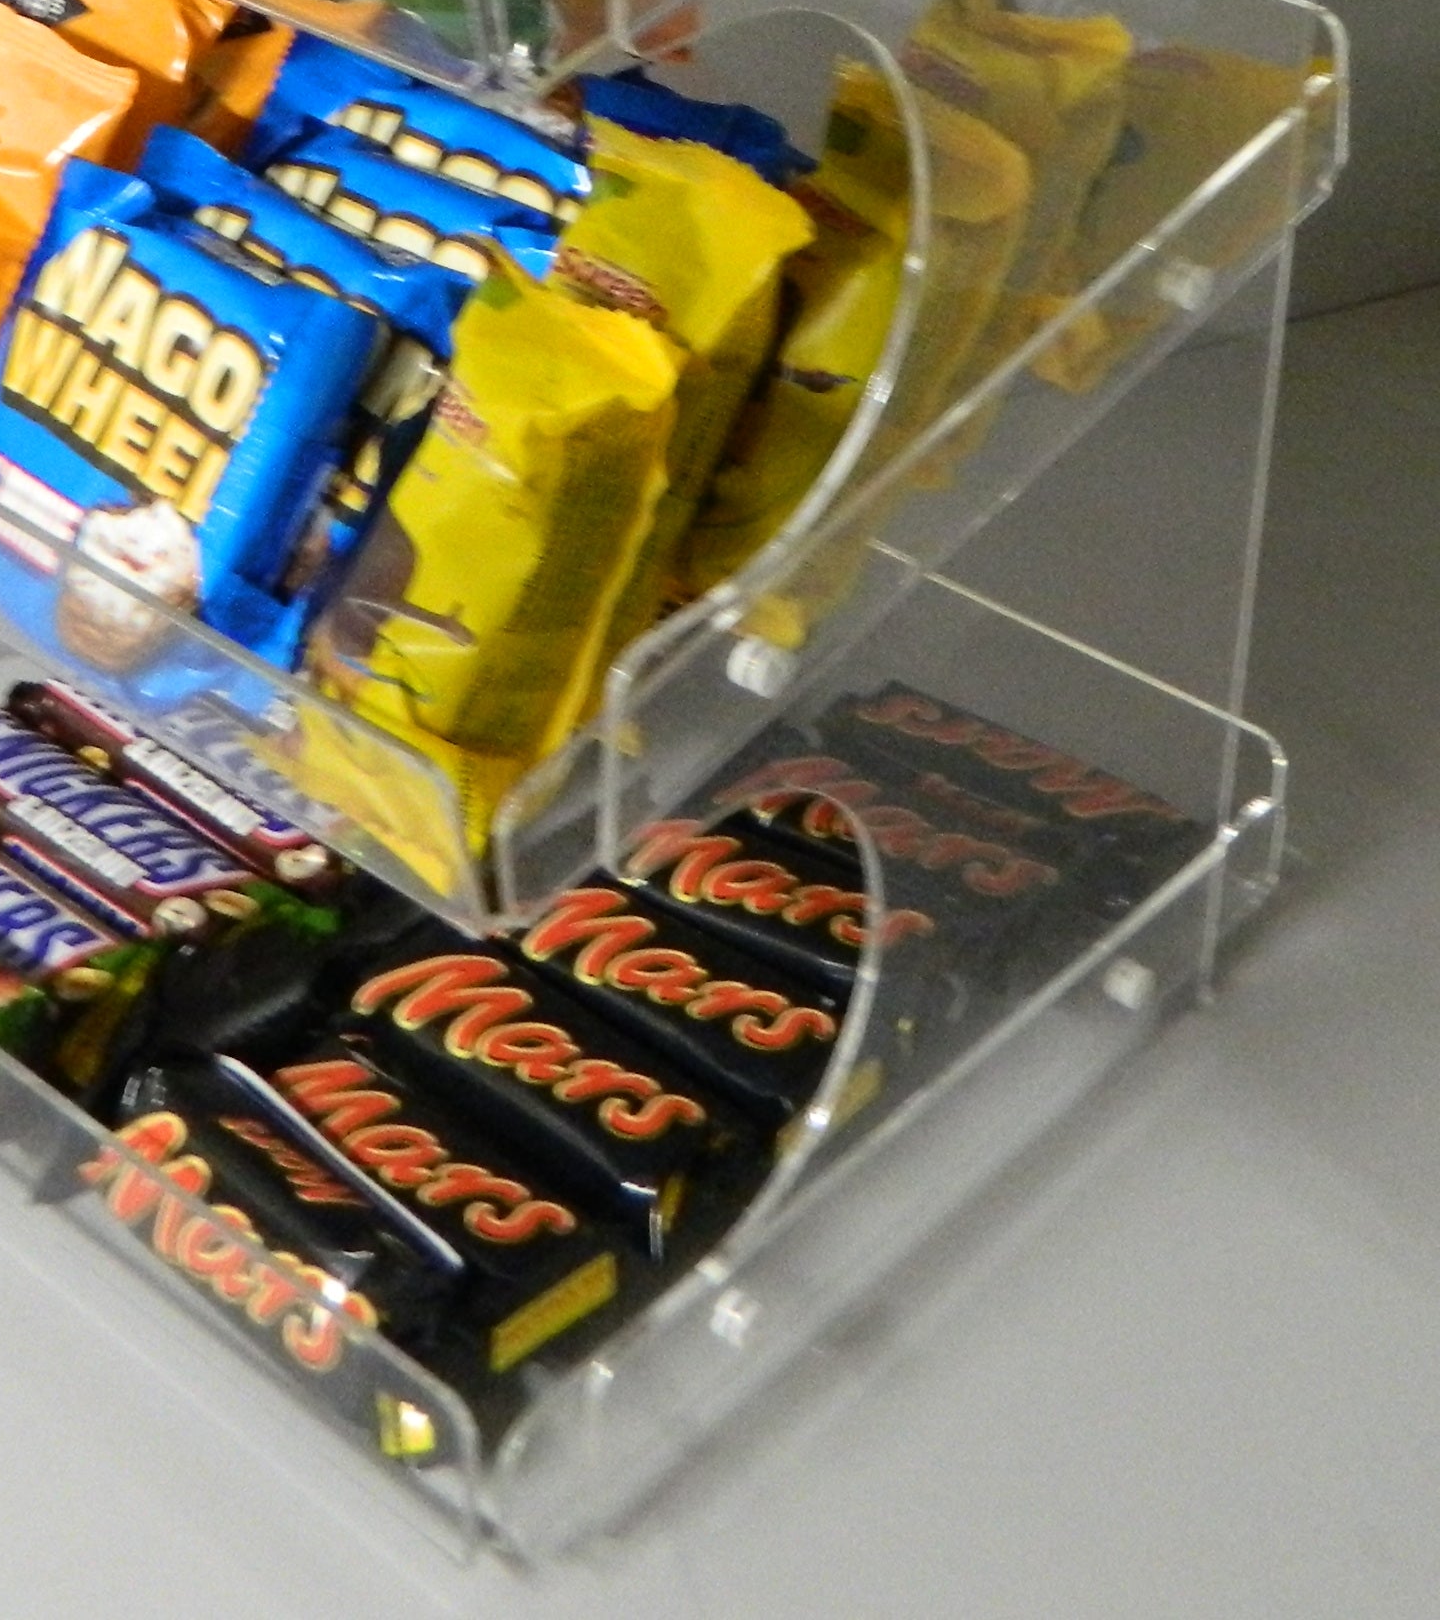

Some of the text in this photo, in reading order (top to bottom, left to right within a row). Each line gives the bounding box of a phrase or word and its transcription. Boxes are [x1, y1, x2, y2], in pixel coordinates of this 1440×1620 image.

[520, 886, 837, 1052] Mars
[626, 816, 938, 949] Mars
[350, 952, 707, 1141] Mars
[78, 1111, 380, 1371] Mars
[274, 1057, 579, 1245] Mars
